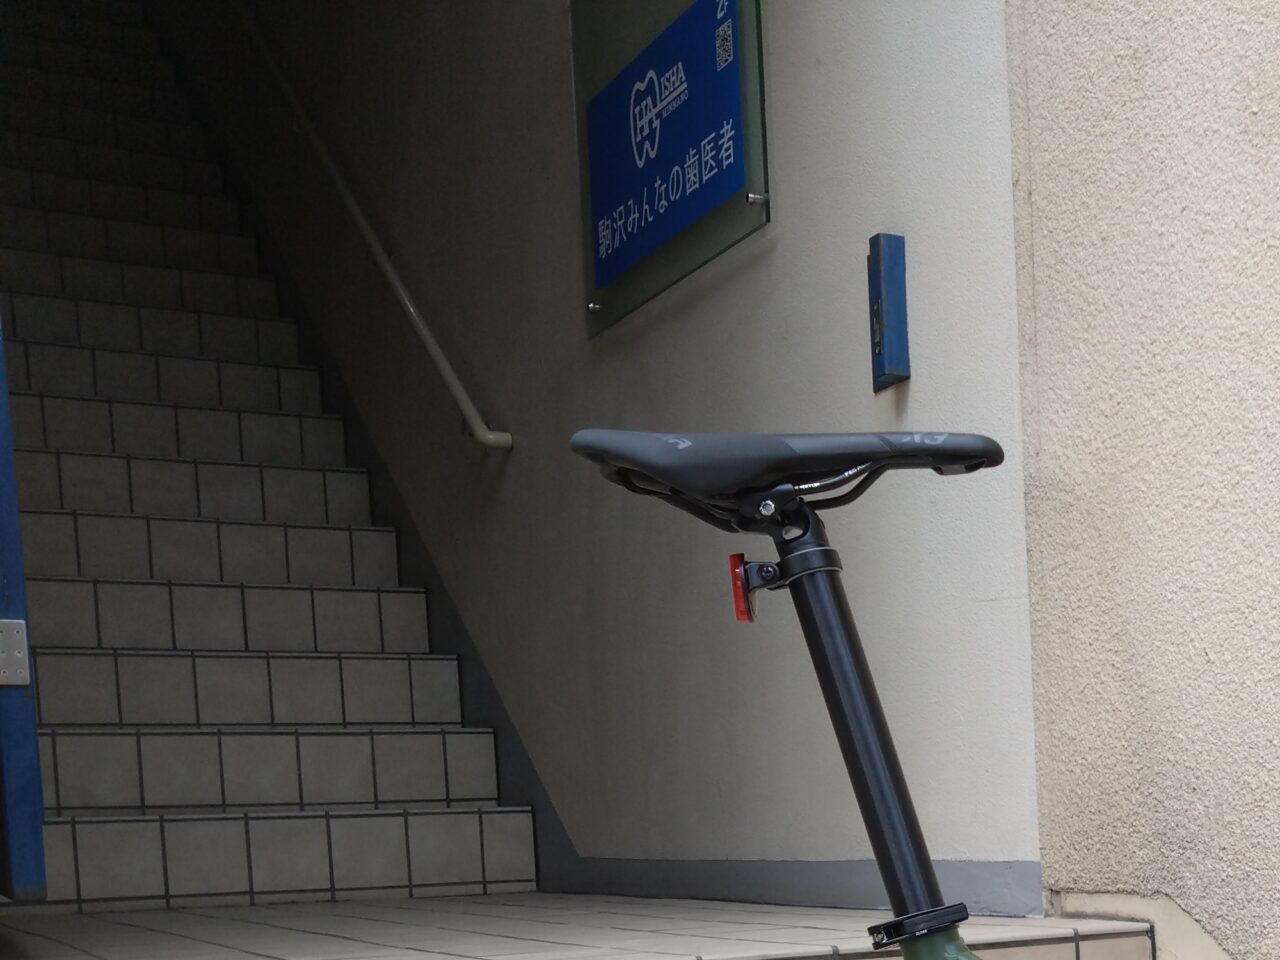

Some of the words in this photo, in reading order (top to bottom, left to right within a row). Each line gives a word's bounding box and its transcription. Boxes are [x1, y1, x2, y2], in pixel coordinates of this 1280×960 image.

[598, 118, 735, 259] 駒沢みんなの歯医者
